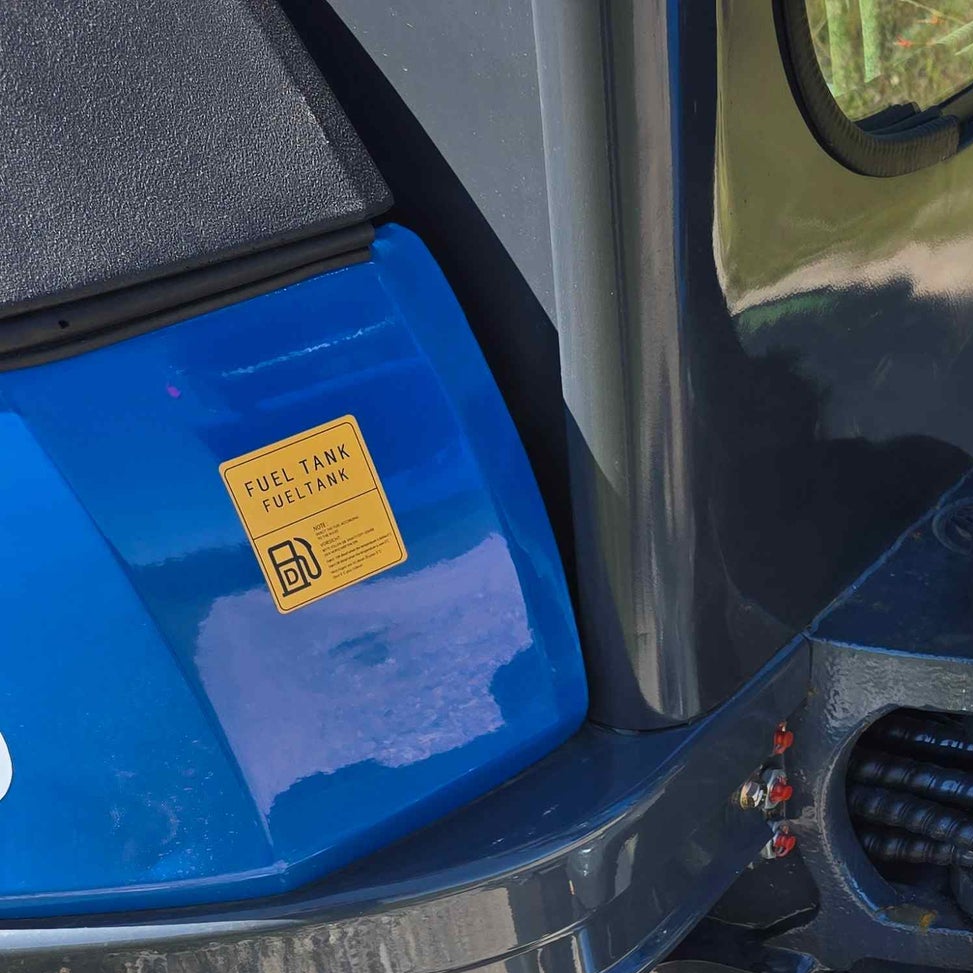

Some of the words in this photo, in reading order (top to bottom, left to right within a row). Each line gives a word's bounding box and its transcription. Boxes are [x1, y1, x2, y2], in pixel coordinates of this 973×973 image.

[244, 468, 294, 497] FUEL
[299, 443, 350, 476] TANK
[262, 468, 349, 513] FUELTANK
[283, 567, 299, 585] D
